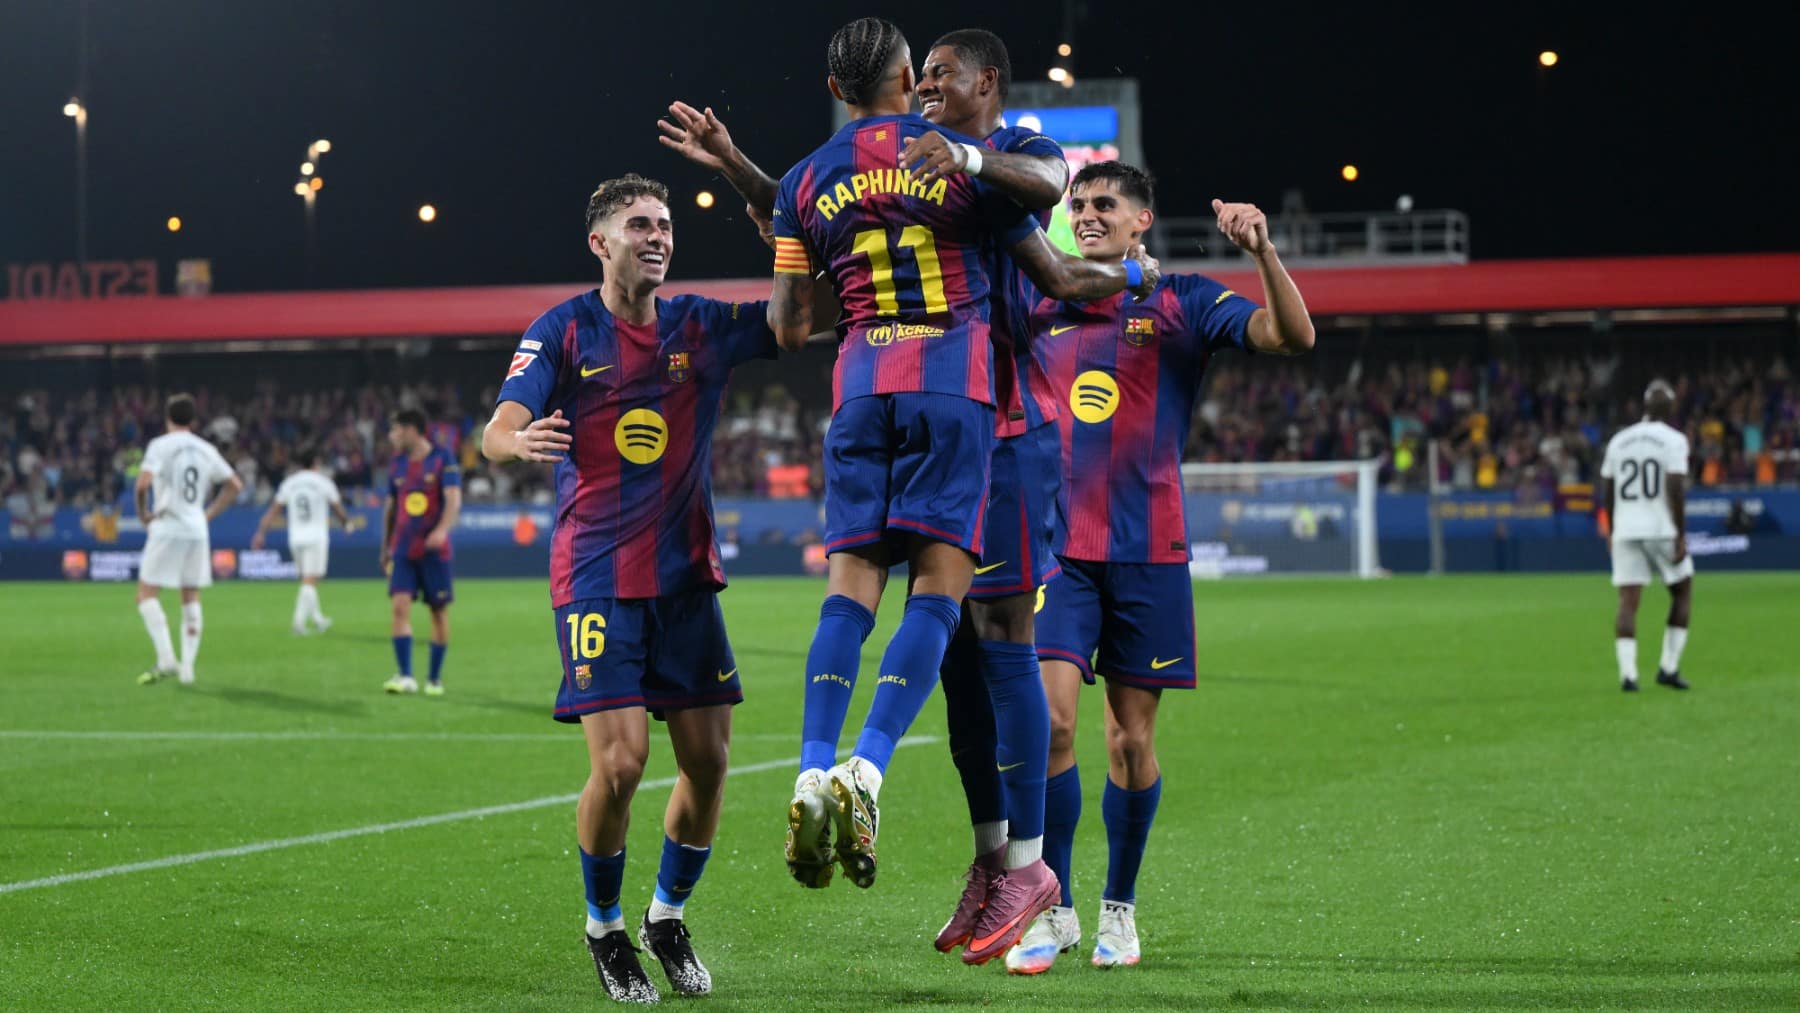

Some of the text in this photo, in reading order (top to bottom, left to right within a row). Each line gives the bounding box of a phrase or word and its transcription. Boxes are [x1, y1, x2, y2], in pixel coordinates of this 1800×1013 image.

[816, 168, 948, 221] RAPHINHA
[852, 225, 949, 315] 11
[183, 466, 199, 504] 8
[1620, 458, 1660, 500] 20
[566, 613, 606, 660] 16
